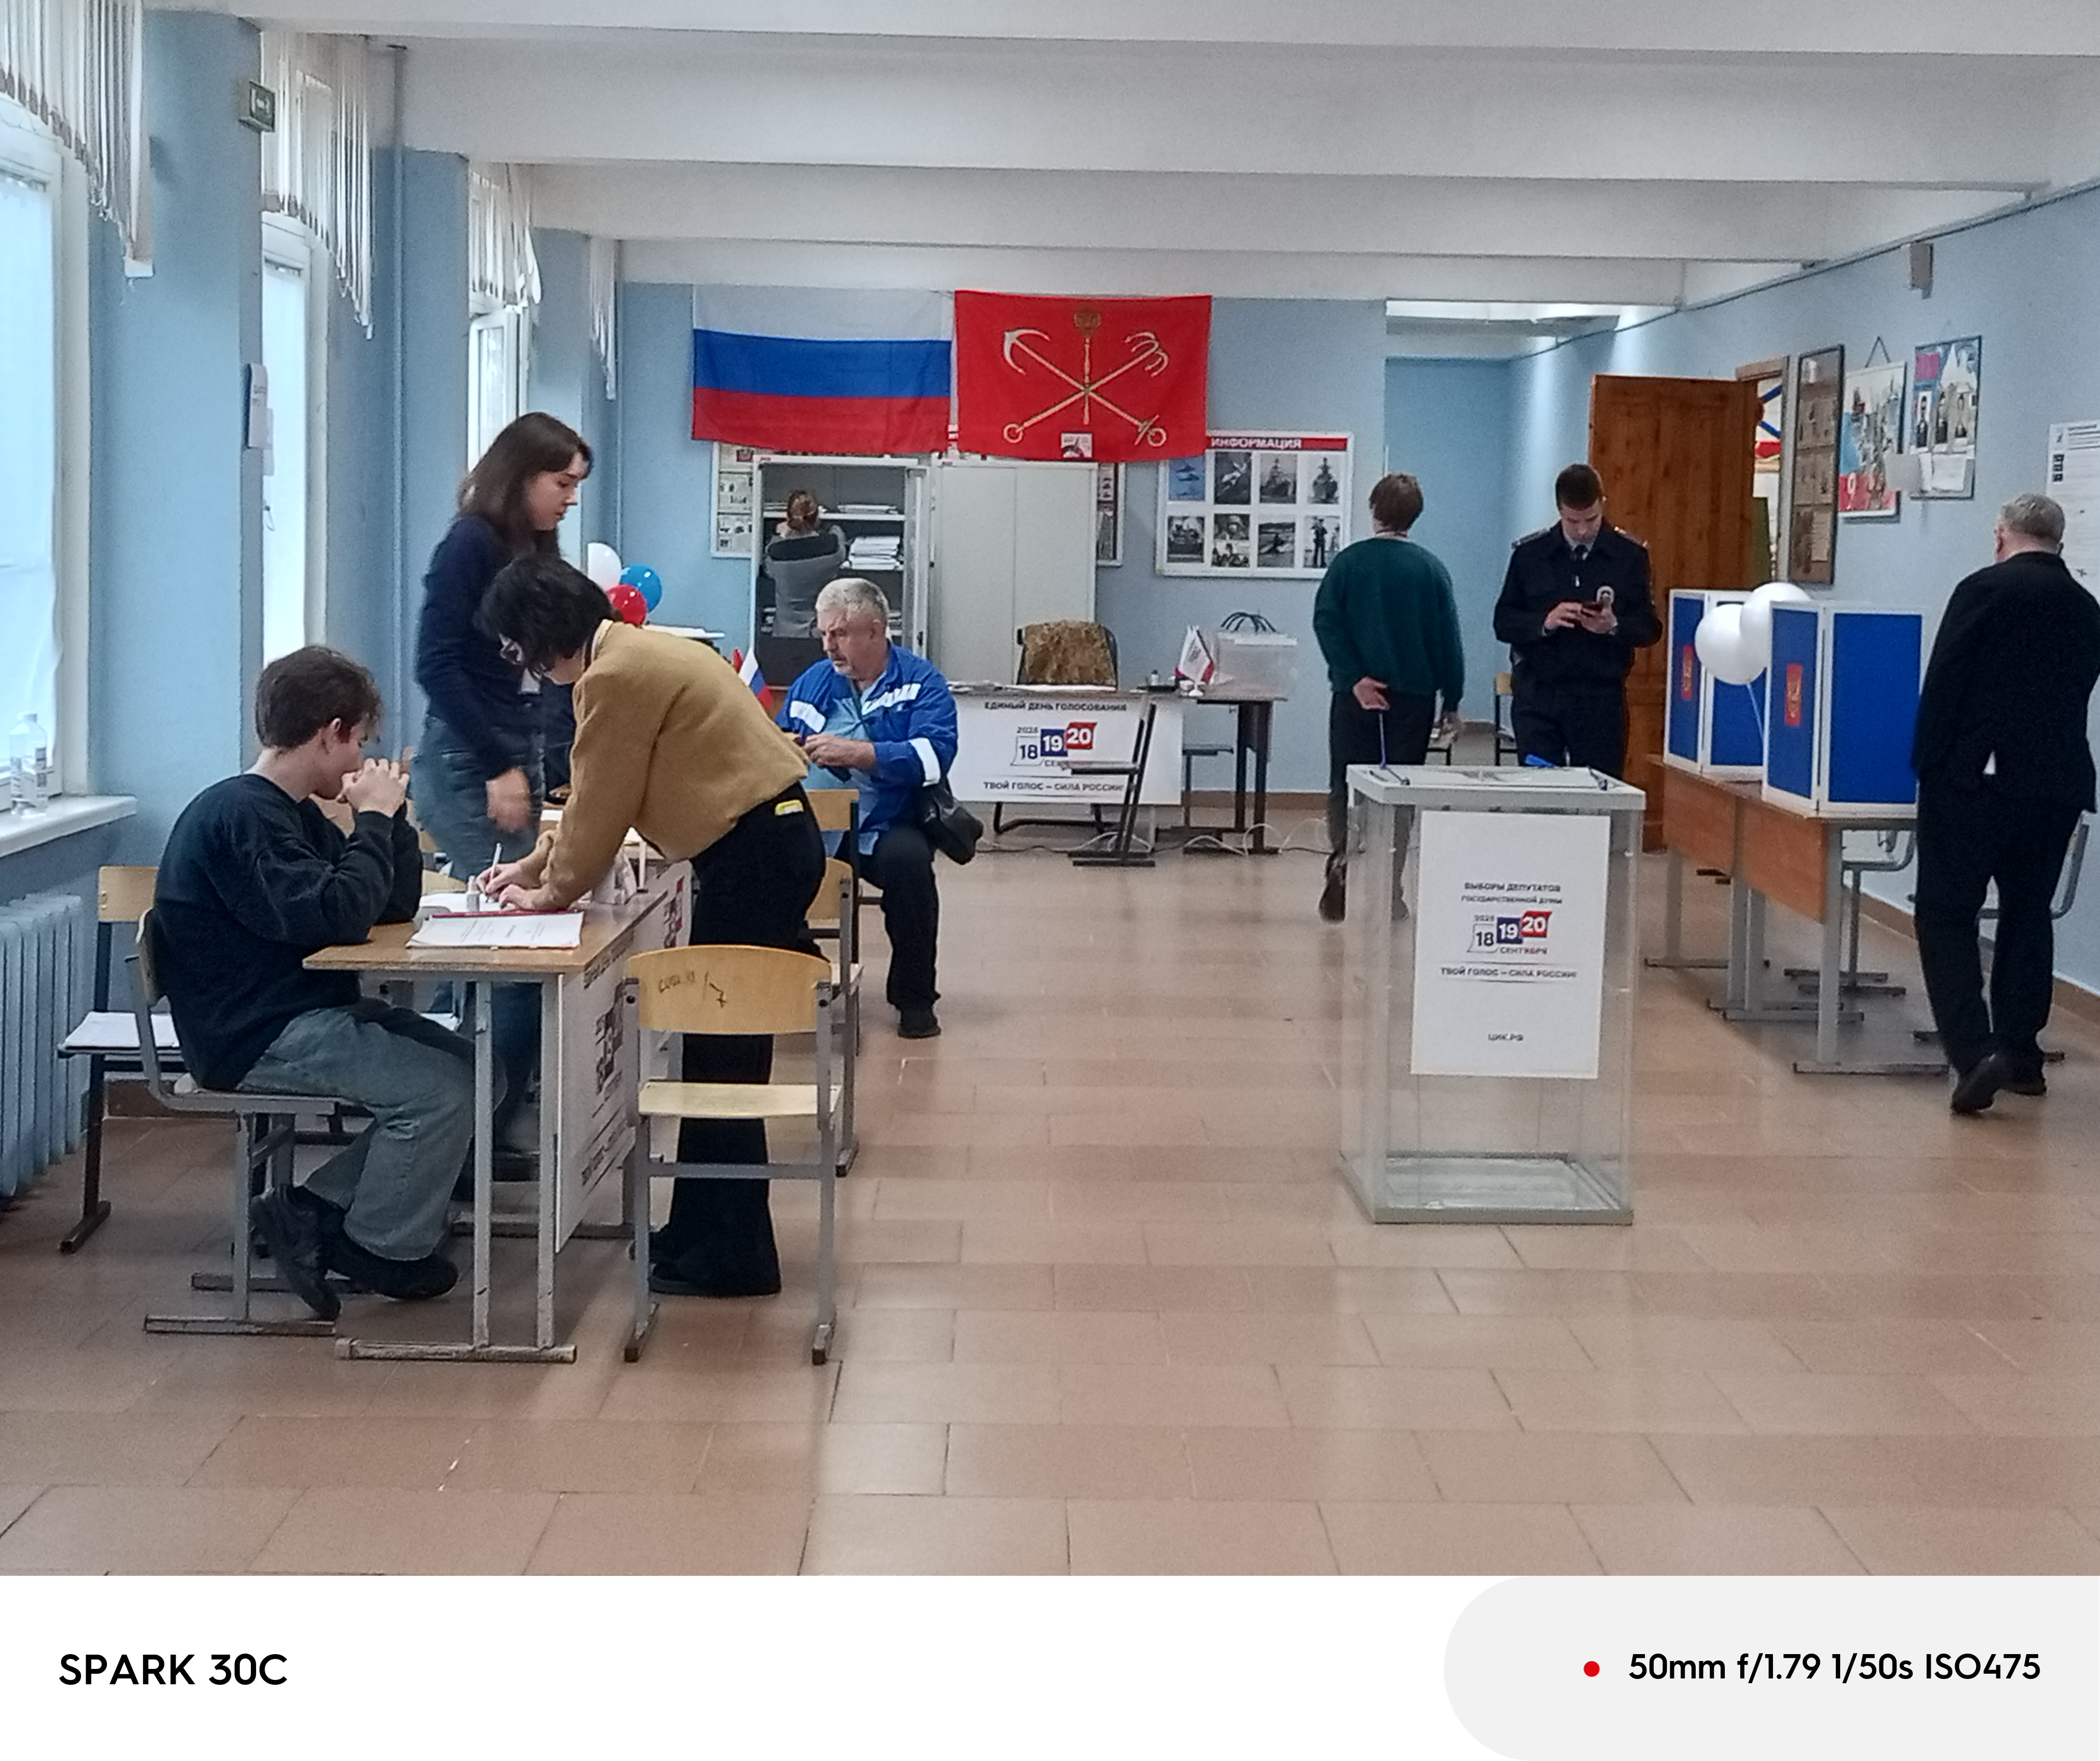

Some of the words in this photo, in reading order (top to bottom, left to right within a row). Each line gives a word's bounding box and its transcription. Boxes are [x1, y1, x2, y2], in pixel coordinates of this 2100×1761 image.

[1211, 437, 1302, 449] ИНФОРМАЦИЯ
[984, 700, 1026, 710] ЕДИНЫЙ
[1028, 703, 1054, 711] ДЕНЬ
[1055, 702, 1127, 712] ГОЛОСОВАНИЯ
[1019, 745, 1038, 760] 18
[1043, 735, 1063, 752] 19
[1066, 728, 1091, 745] 20
[983, 780, 1009, 789] ТВОЙ
[1011, 782, 1043, 791] ГОЛОС
[1464, 882, 1505, 891] ВЫБОРЫ
[1506, 883, 1561, 892] ДЕПУТАТОВ
[1476, 931, 1494, 947] 18
[1499, 923, 1518, 939] 19
[1522, 916, 1546, 932] 20
[1441, 966, 1465, 975] ТВОЙ
[1467, 967, 1499, 976] ГОЛОС
